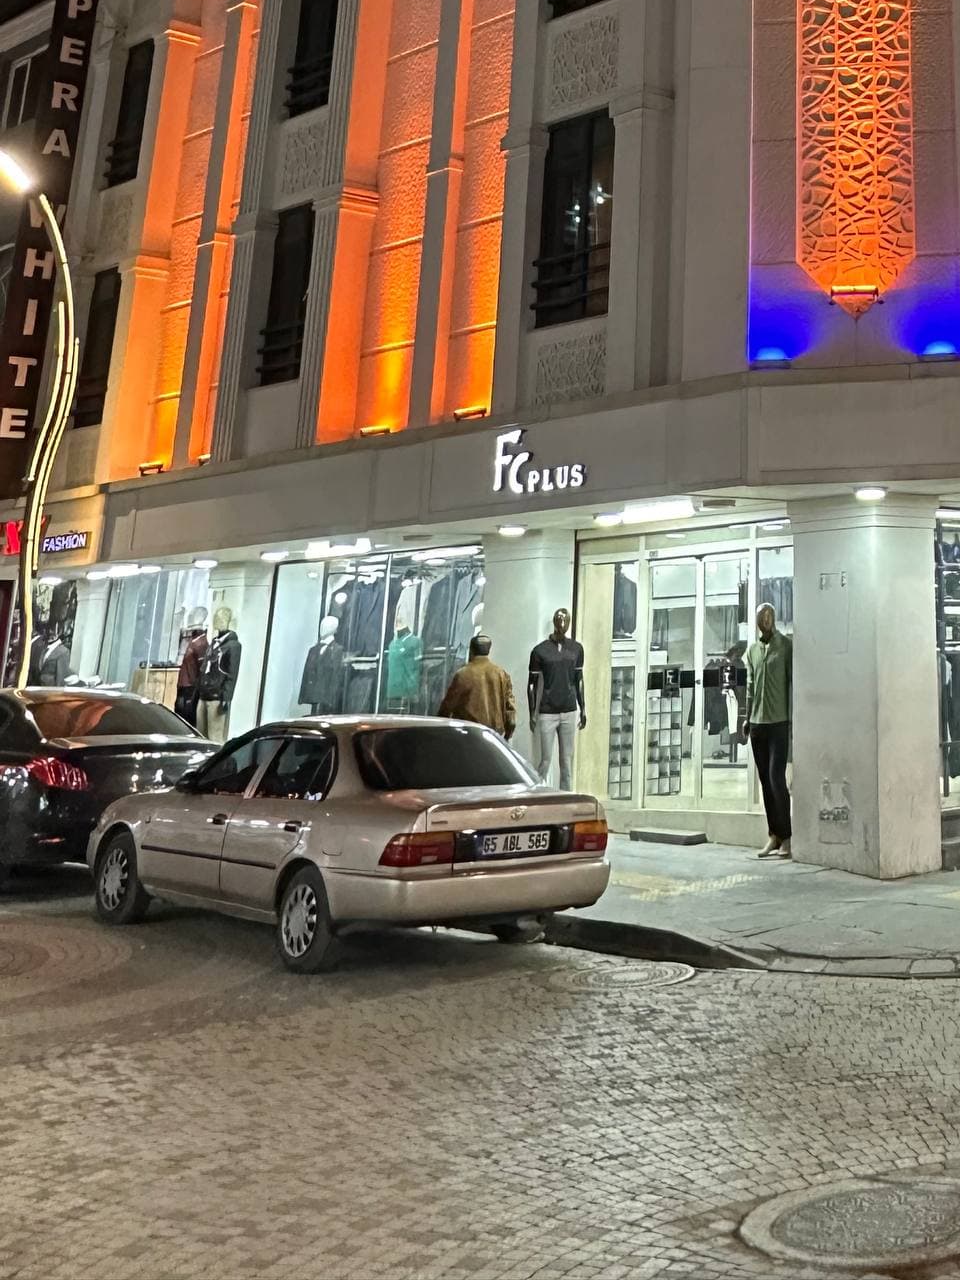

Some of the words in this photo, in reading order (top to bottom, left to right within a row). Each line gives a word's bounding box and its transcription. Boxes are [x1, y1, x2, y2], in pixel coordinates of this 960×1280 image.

[493, 429, 530, 493] FC
[528, 464, 584, 493] PLUS
[42, 533, 87, 552] FASHION
[484, 837, 498, 853] 65
[503, 835, 522, 852] ABL
